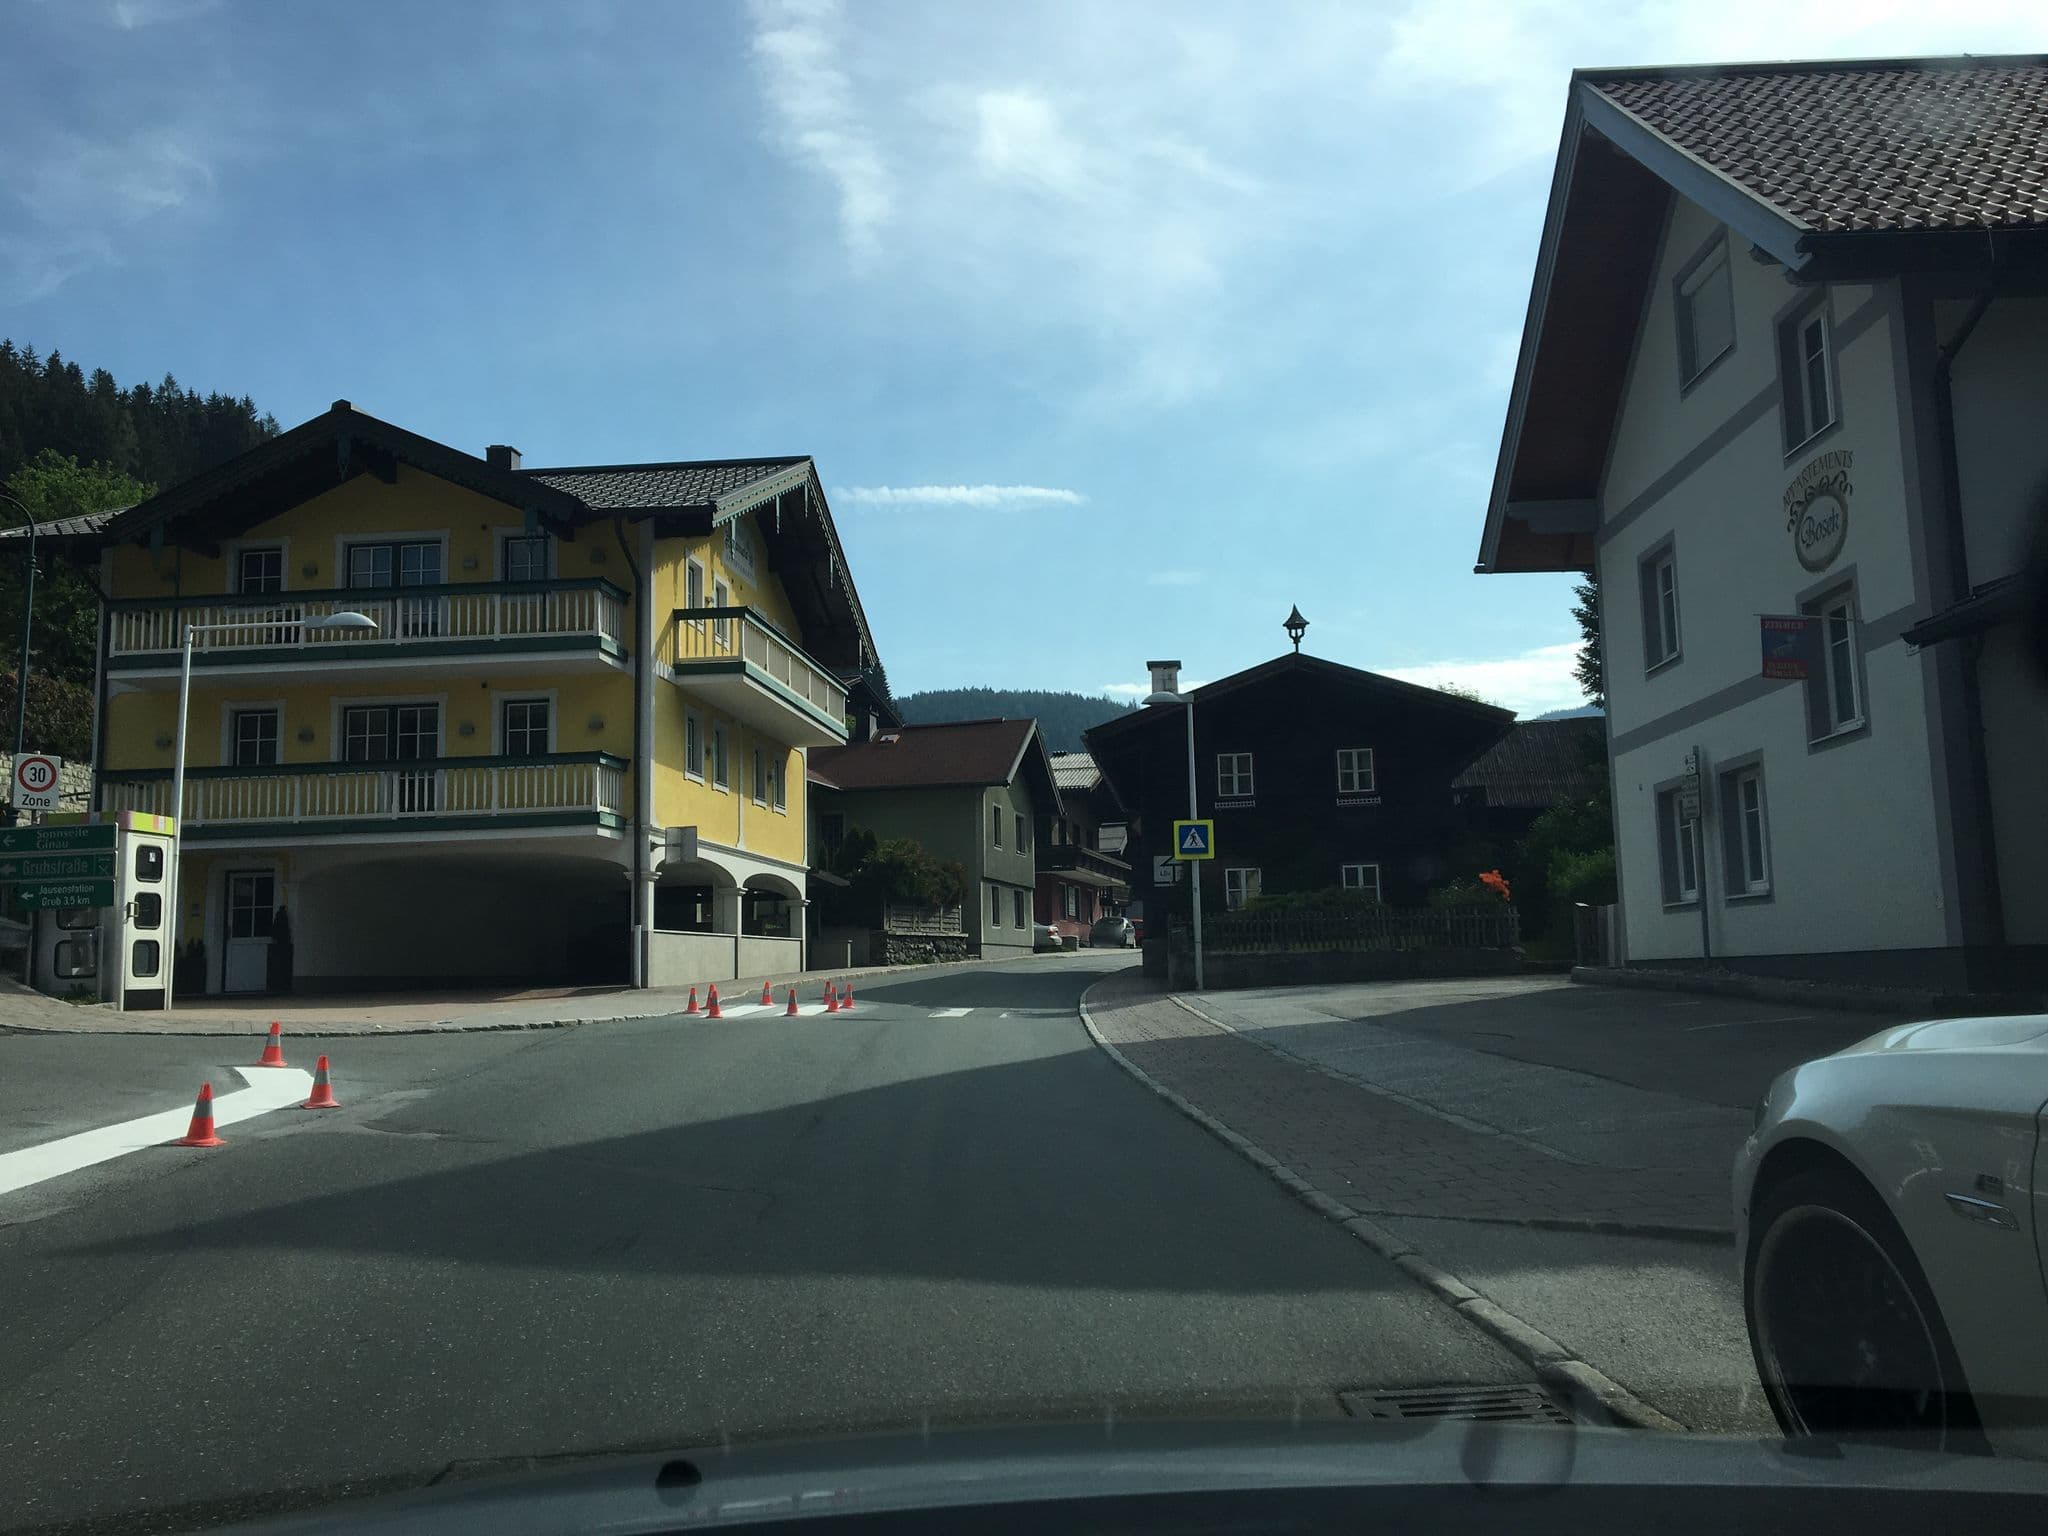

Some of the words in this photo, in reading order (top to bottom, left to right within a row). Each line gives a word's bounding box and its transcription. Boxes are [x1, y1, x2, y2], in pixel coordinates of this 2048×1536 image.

[29, 766, 46, 783] 30
[22, 793, 51, 807] Zone
[36, 828, 89, 839] Sonnseite
[39, 884, 95, 896] Jausenstation
[41, 896, 62, 906] Grub
[77, 895, 90, 905] km
